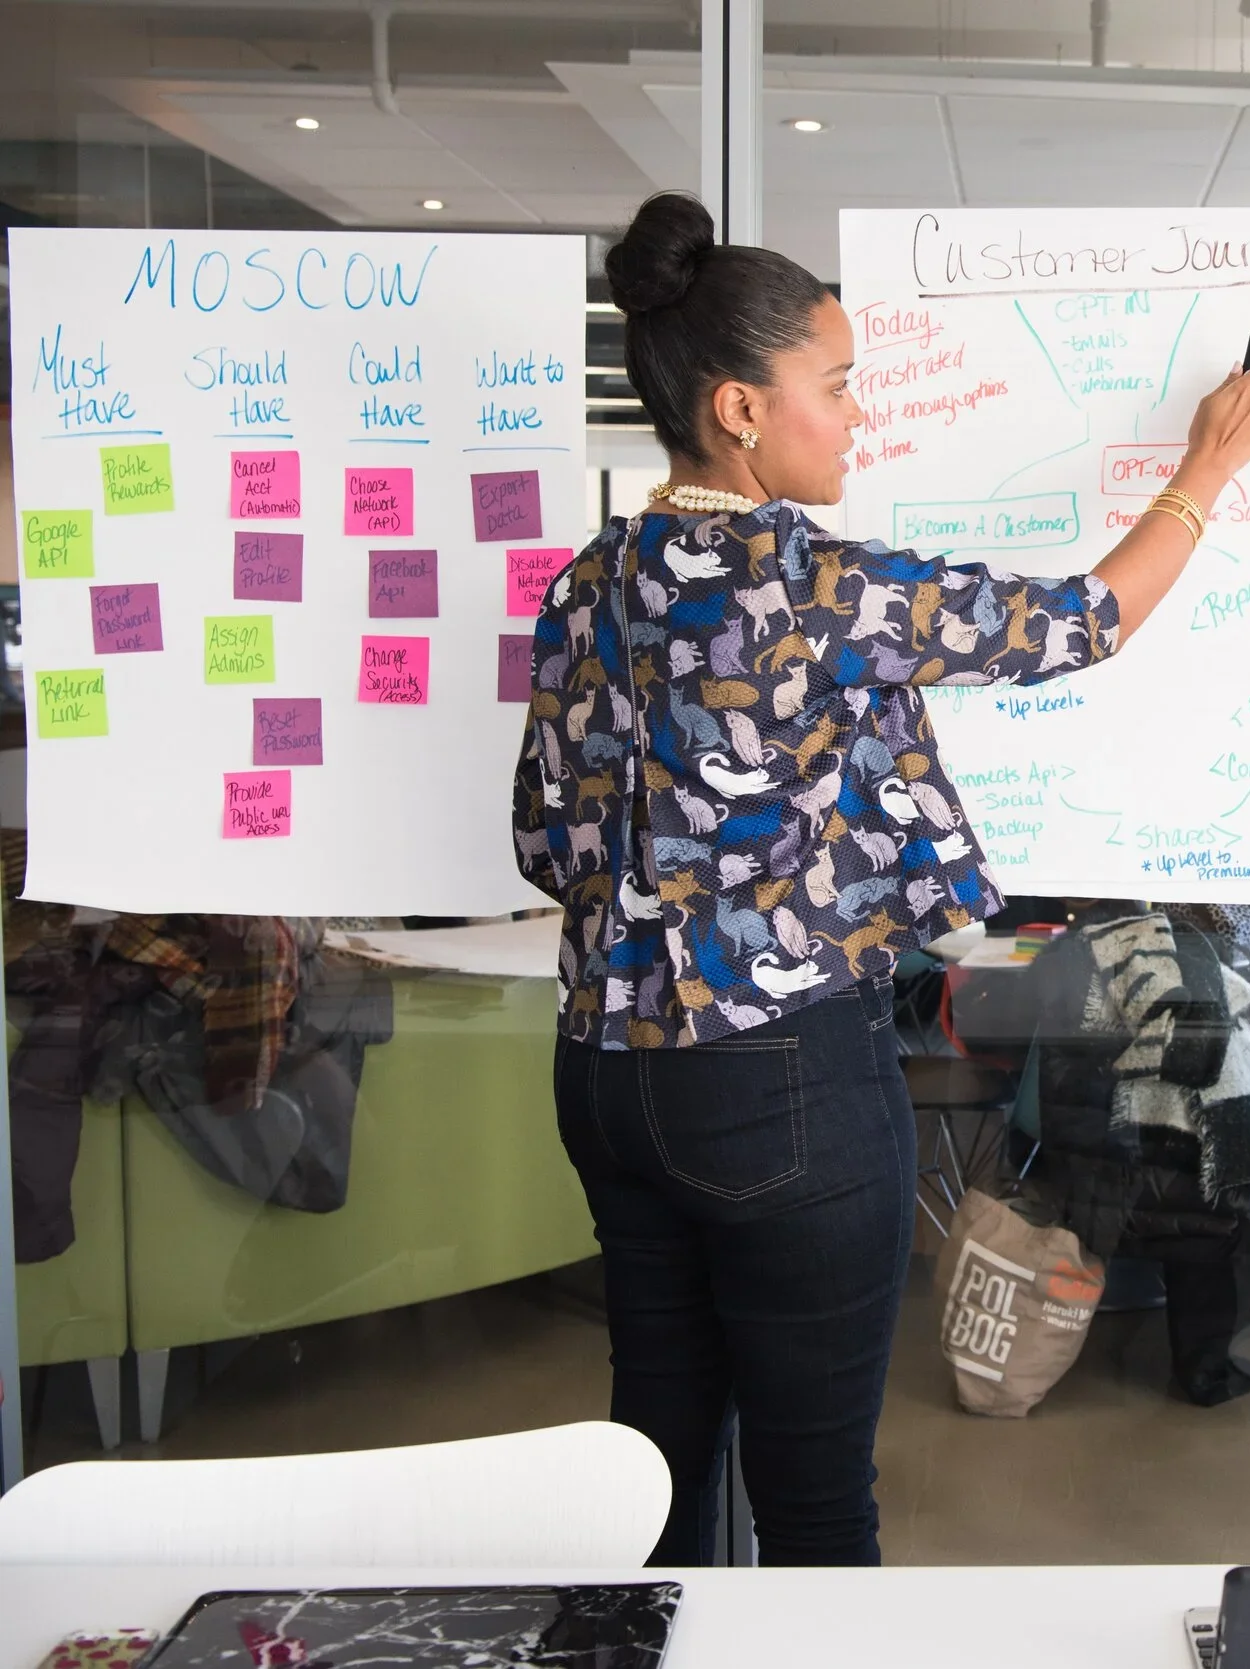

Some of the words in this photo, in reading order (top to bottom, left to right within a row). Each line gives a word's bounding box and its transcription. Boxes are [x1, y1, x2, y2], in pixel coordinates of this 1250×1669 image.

[914, 213, 1146, 287] Customer
[125, 239, 438, 311] MOSCOW
[33, 324, 111, 393] Must
[185, 347, 288, 390] Should
[349, 343, 422, 386] Could
[476, 351, 535, 387] Want
[543, 354, 565, 381] to
[855, 341, 966, 403] Frustrated
[58, 391, 136, 430] Have
[230, 390, 291, 428] Have
[360, 396, 426, 430] Have
[477, 401, 543, 435] Have
[864, 400, 897, 436] Not
[901, 392, 964, 426] enough
[233, 457, 276, 478] Cancel
[856, 444, 875, 472] No
[878, 438, 919, 462] time
[104, 458, 153, 483] Profile
[107, 476, 170, 502] Rewards
[244, 478, 273, 496] Acct
[350, 475, 391, 497] Choose
[479, 473, 530, 511] Export
[239, 497, 301, 517] (Automatic)
[353, 495, 398, 514] Network
[27, 516, 83, 549] Google
[368, 512, 401, 532] (API)
[487, 503, 529, 536] Data
[905, 513, 967, 541] Becomes
[974, 514, 986, 538] A
[994, 512, 1074, 540] Customer
[38, 547, 68, 569] API
[239, 539, 274, 563] Edit
[508, 555, 557, 574] Disable
[240, 565, 293, 589] Profile
[372, 556, 433, 583] Facebook
[95, 587, 134, 618] Forgot
[97, 605, 152, 638] Password
[208, 624, 259, 656] Assign
[208, 650, 265, 675] Admins
[364, 646, 409, 673] Change
[41, 674, 104, 705] Referral
[366, 670, 420, 693] Security
[258, 707, 302, 735] Reset
[1009, 696, 1031, 721] Up
[261, 726, 323, 756] Password
[226, 780, 274, 808] Provide
[985, 790, 1044, 811] Social
[230, 805, 269, 829] Public
[246, 823, 281, 836] Access
[983, 818, 1044, 842] Backup
[1135, 823, 1217, 850] Shares
[986, 847, 1031, 866] Cloud
[1157, 854, 1177, 877] Up
[1216, 849, 1232, 865] to
[960, 1263, 1019, 1323] POL
[950, 1305, 1018, 1365] BOG
